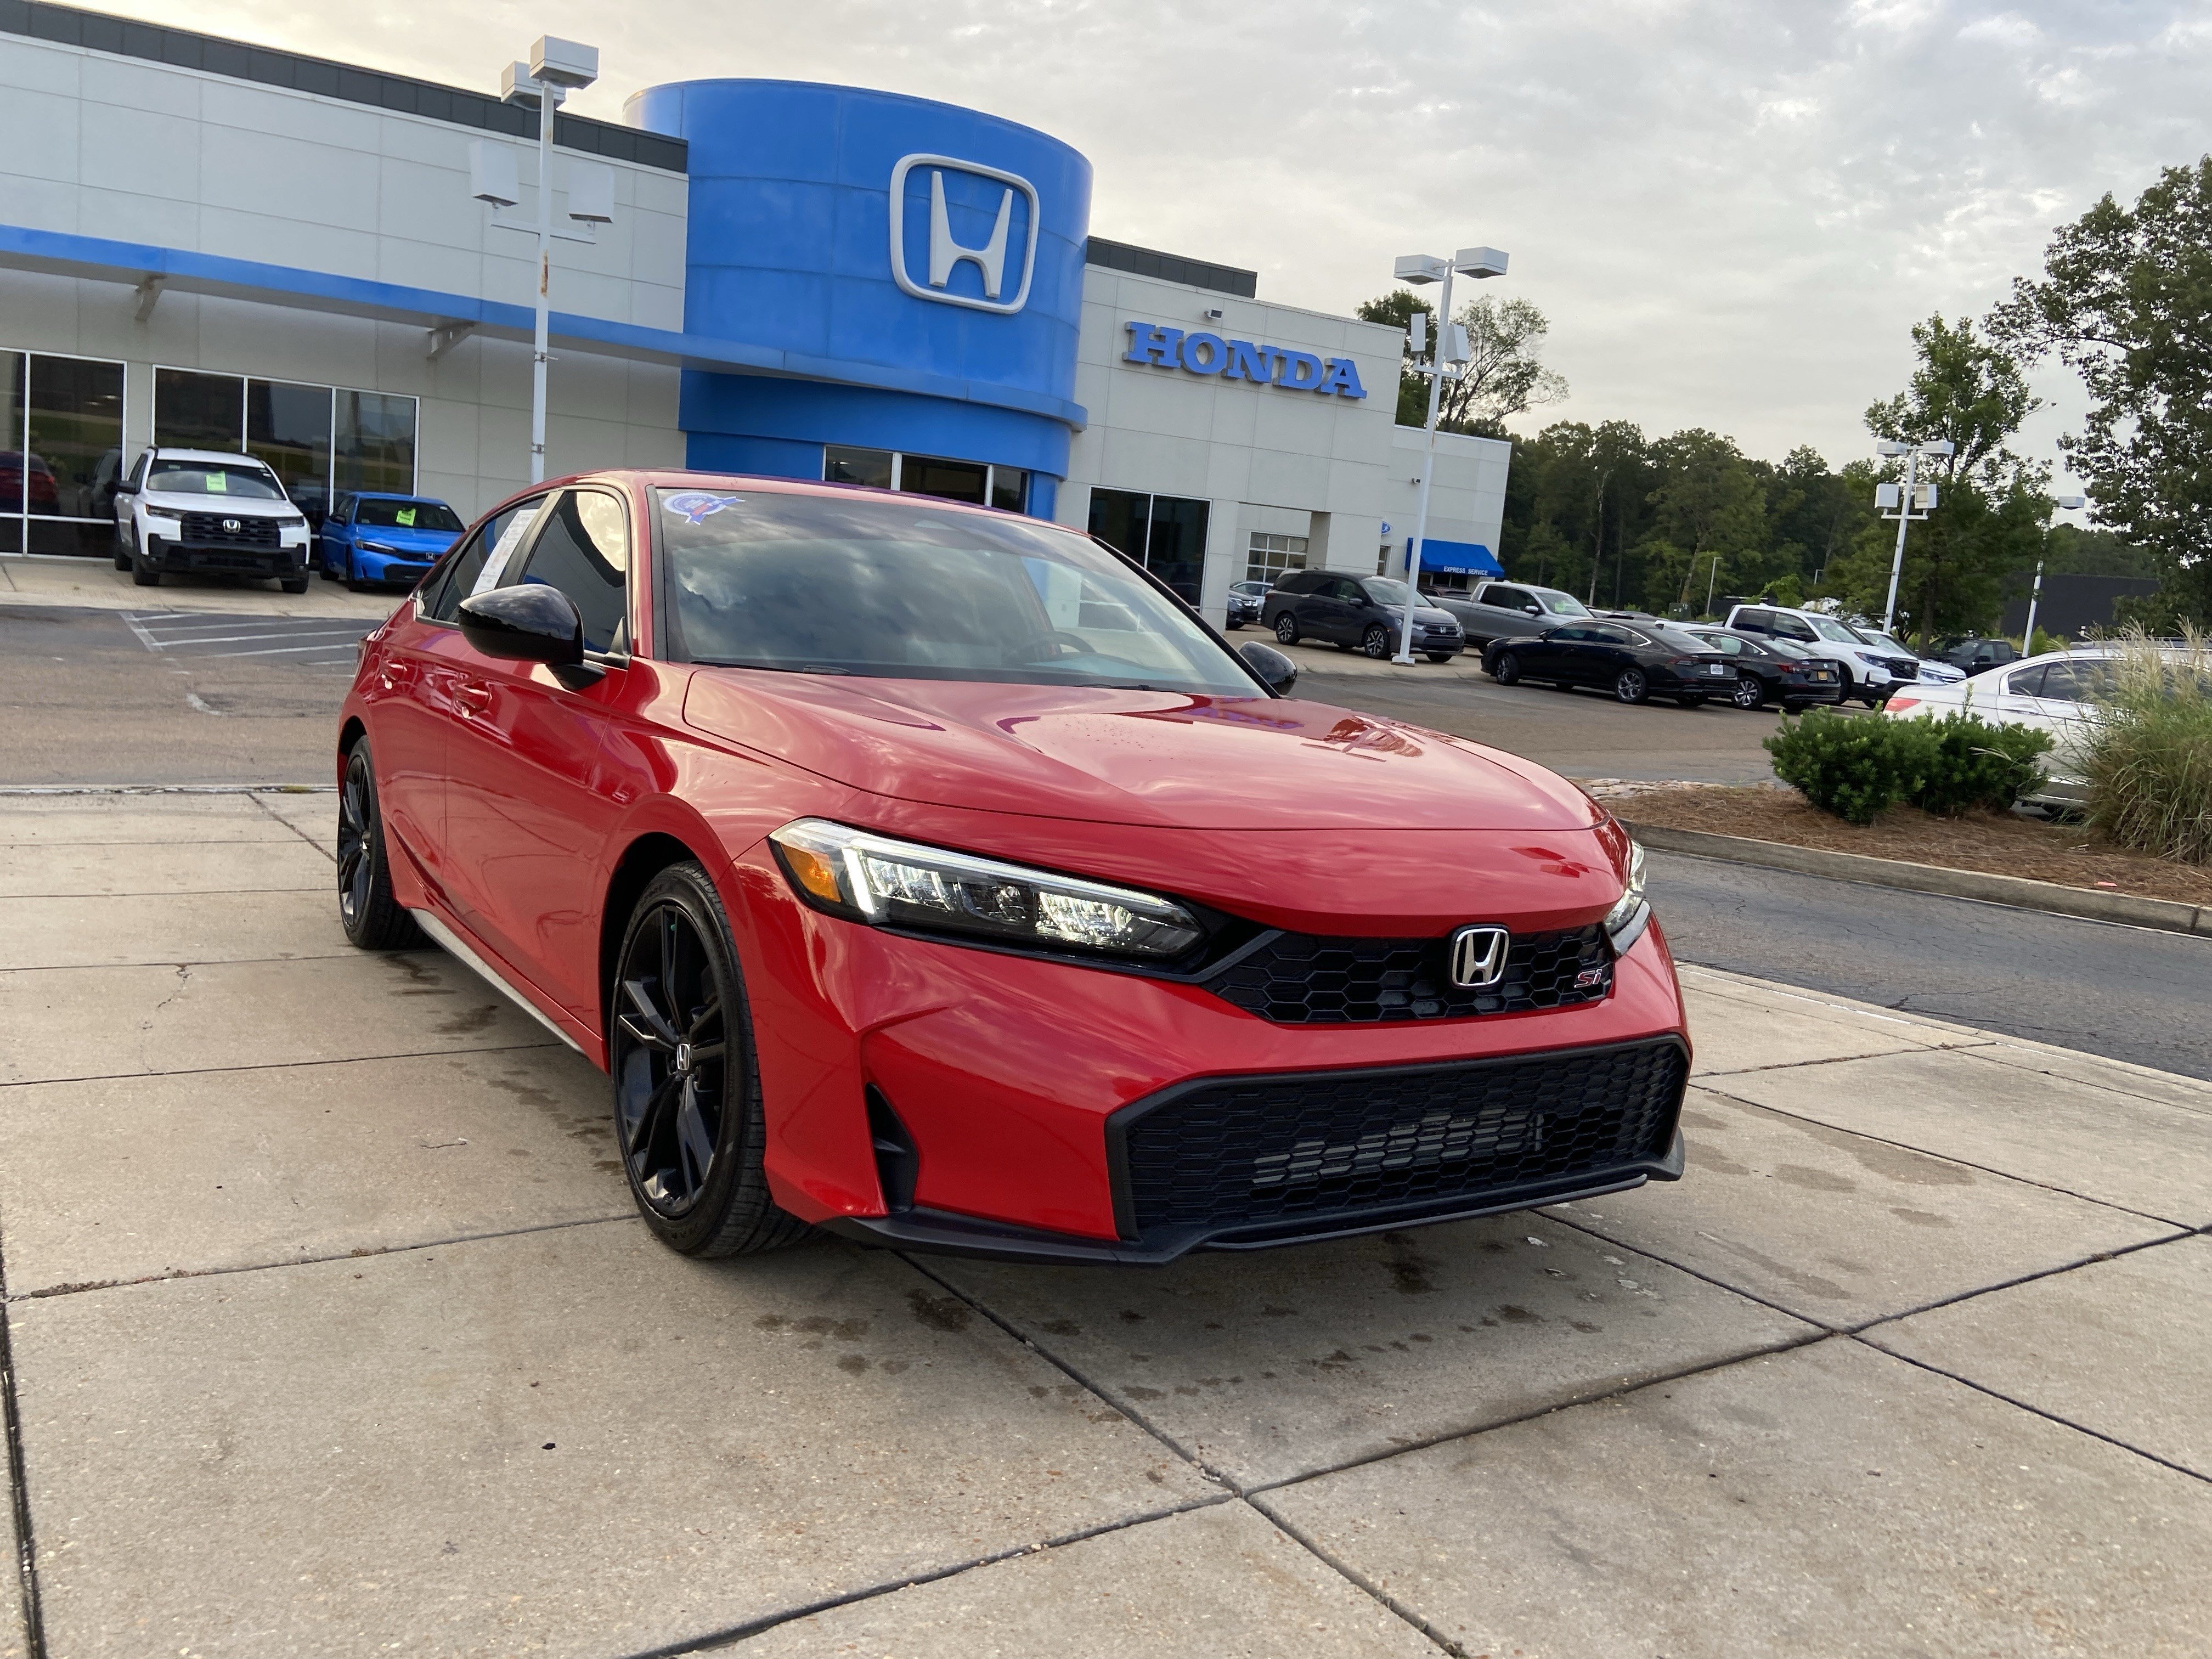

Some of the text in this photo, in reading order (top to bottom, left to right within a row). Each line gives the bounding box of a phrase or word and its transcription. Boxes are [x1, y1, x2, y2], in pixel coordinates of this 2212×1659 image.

[1122, 320, 1367, 399] HONDA
[1443, 566, 1466, 574] EXPRESS
[1573, 968, 1602, 988] Si
